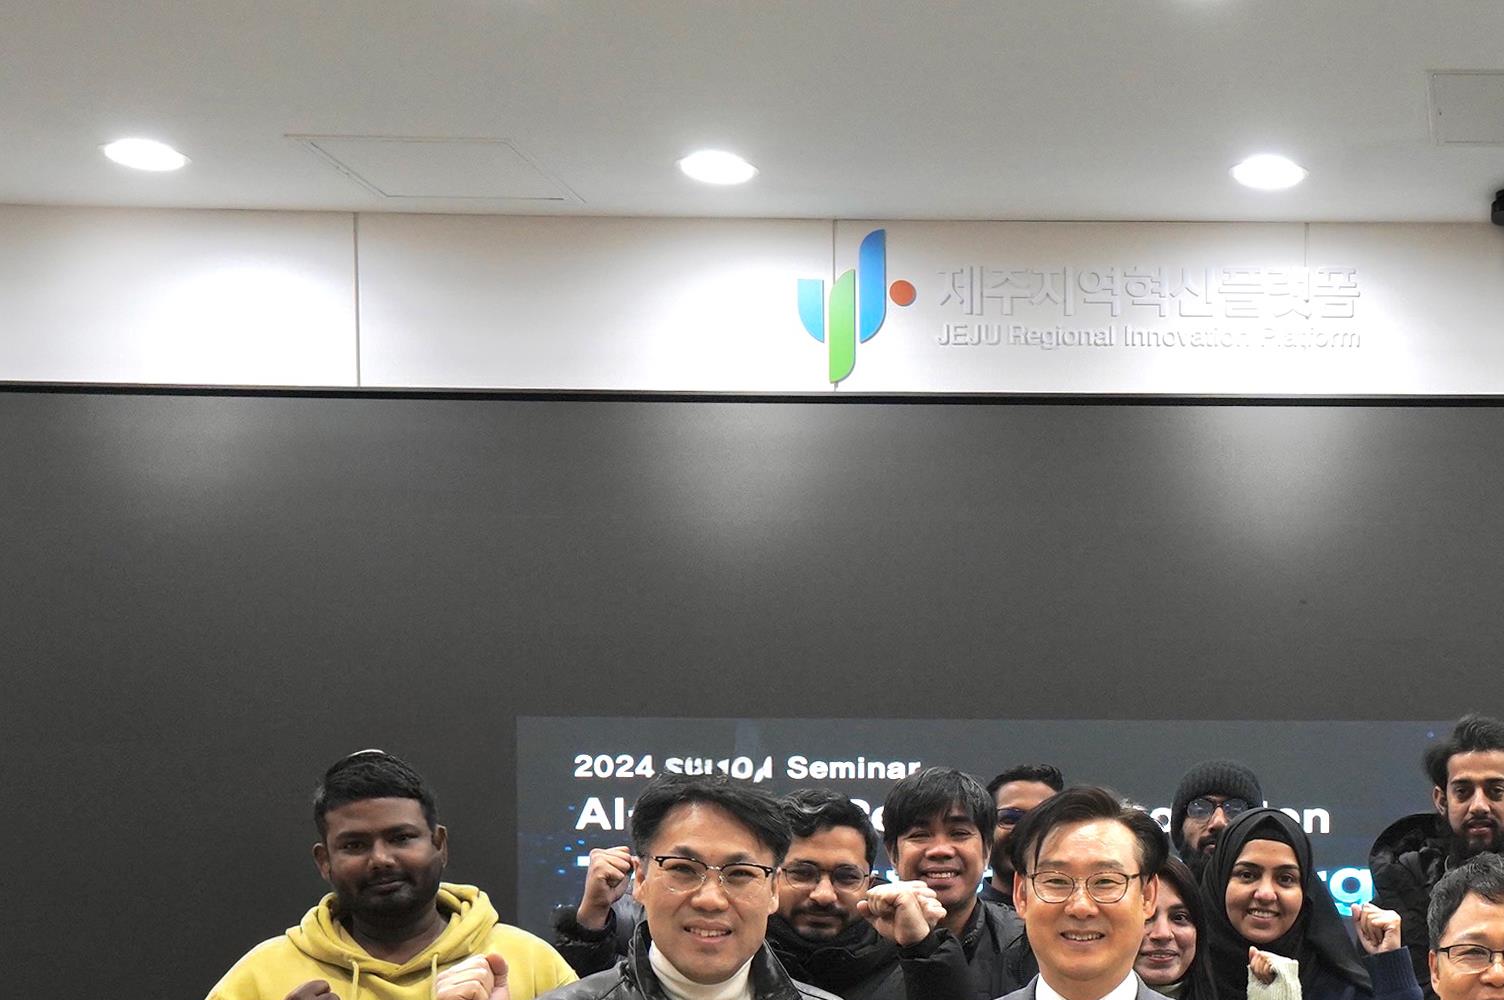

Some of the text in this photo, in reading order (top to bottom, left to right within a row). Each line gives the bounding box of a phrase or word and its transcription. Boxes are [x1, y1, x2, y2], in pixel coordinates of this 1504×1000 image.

[937, 265, 1361, 319] 제주지역혁신플랫폼
[937, 323, 1361, 350] JEJU Regional Innovation Platform
[574, 754, 656, 779] 2024
[786, 755, 922, 780] Seminar
